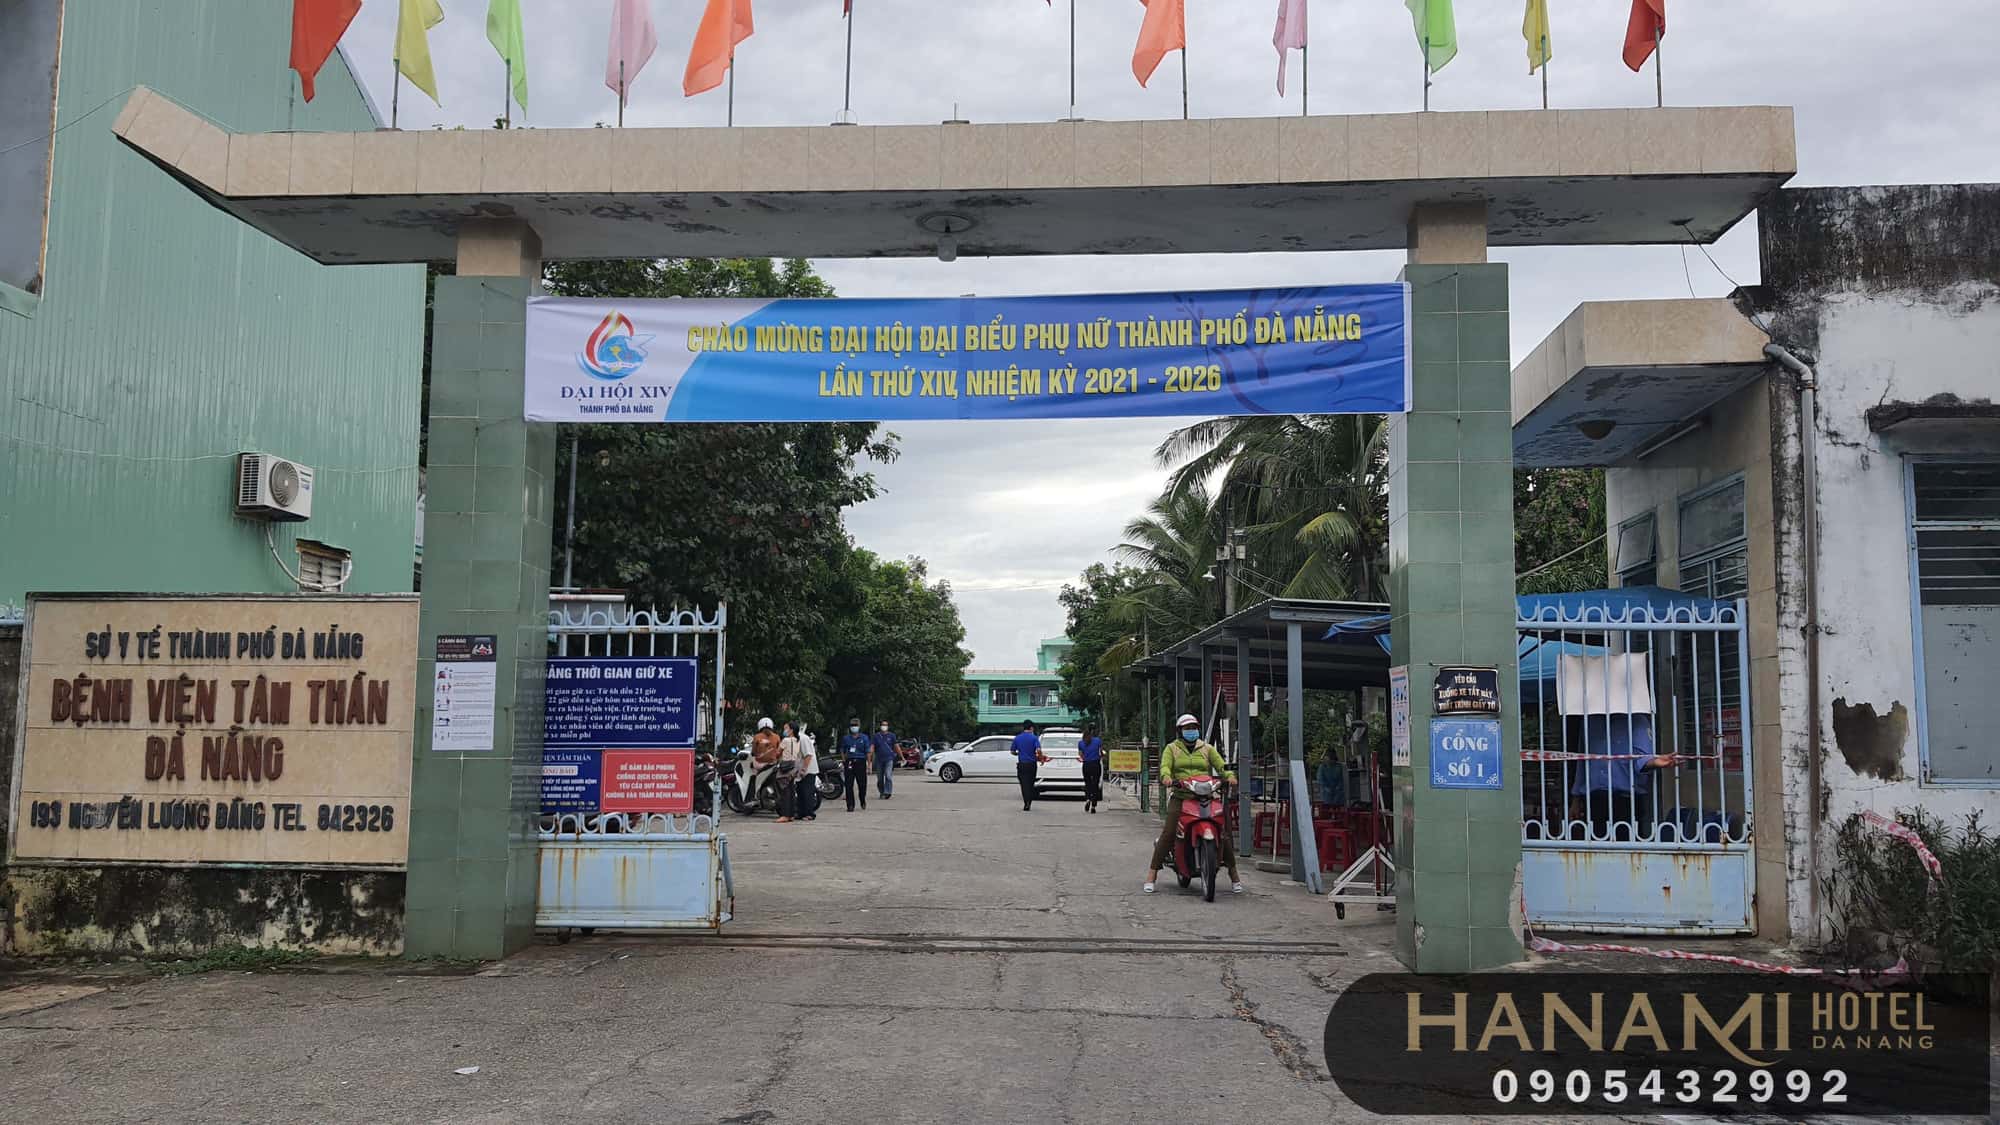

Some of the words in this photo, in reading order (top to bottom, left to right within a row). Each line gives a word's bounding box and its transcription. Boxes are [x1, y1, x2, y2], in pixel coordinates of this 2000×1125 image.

[687, 320, 749, 353] CHÀO
[755, 321, 823, 354] MỪNG
[829, 325, 868, 358] ĐẠI
[875, 321, 913, 358] HỘI
[919, 325, 958, 358] ĐẠI
[964, 314, 1017, 351] BIỂU
[1023, 323, 1070, 355] PHỤ
[1077, 317, 1111, 350] NỮ
[1116, 315, 1193, 348] THÀNH
[1200, 308, 1251, 345] PHỐ
[1254, 311, 1287, 344] ĐÀ
[1293, 304, 1362, 343] NẴNG
[561, 386, 593, 402] ĐẠI
[600, 382, 633, 402] HỘI
[640, 386, 672, 399] XIV
[818, 362, 863, 397] LẦN
[870, 365, 916, 397] THỨ
[919, 370, 959, 400] XIV,
[965, 363, 1042, 401] NHIỆM
[1048, 363, 1078, 395] KỲ
[1085, 367, 1138, 394] 2021
[1164, 365, 1221, 393] 2026
[580, 403, 604, 414] THÀNH
[605, 402, 620, 414] PHỐ
[621, 403, 632, 414] ĐÀ
[118, 631, 130, 659] Y
[136, 624, 162, 659] TẾ
[168, 627, 231, 660] THÀNH
[237, 624, 277, 660] PHỐ
[546, 664, 572, 679] ẢNG
[575, 664, 600, 679] THỜI
[604, 667, 632, 679] GIAN
[635, 665, 656, 679] GIỮ
[658, 667, 673, 679] XE
[51, 672, 133, 728] BỆNH
[147, 672, 218, 728] VIỆN
[231, 674, 291, 726] TÂM
[145, 729, 185, 782] ĐÀ
[201, 725, 284, 782] NẴNG
[1448, 756, 1471, 777] SỐ
[1476, 763, 1484, 778] 1
[31, 800, 62, 828] 193
[317, 804, 394, 832] 842326
